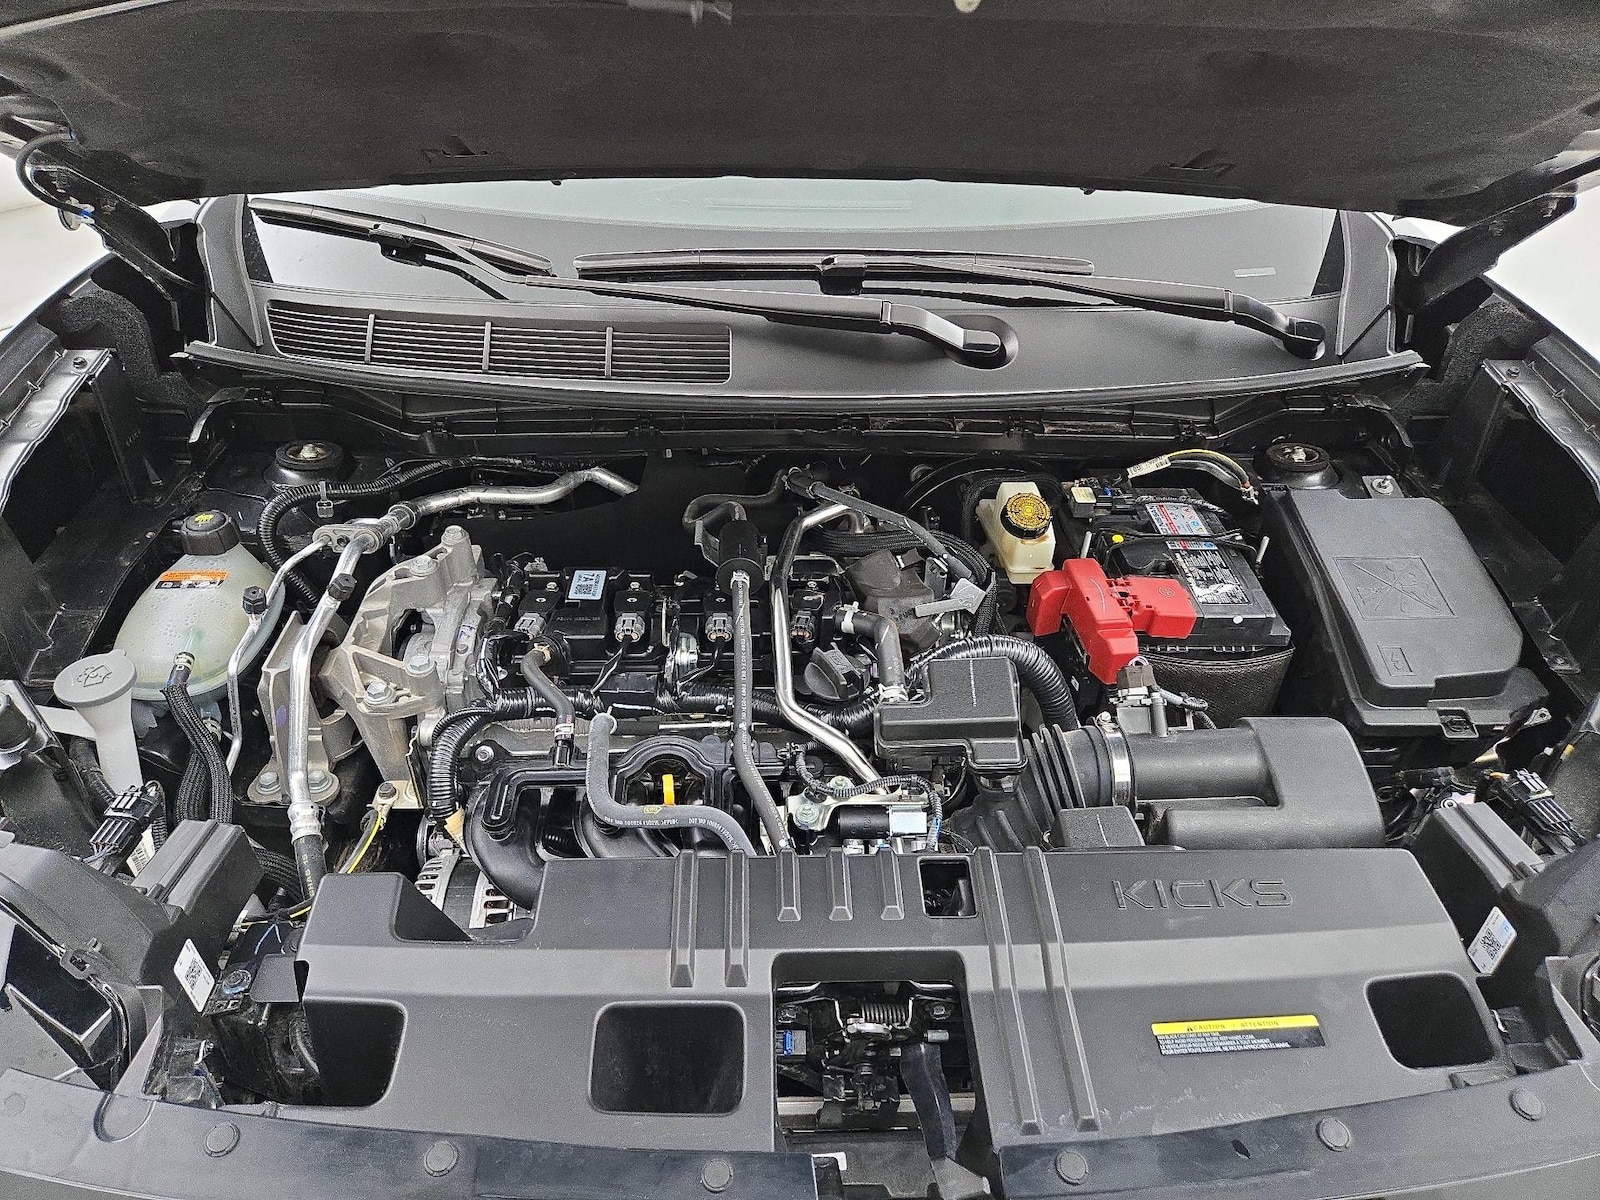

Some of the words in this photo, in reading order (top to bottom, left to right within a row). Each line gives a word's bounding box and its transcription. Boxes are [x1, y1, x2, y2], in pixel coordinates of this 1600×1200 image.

[1112, 878, 1293, 909] KICKS
[1194, 1023, 1226, 1031] CAUTION
[1240, 1020, 1279, 1028] ATTENTION
